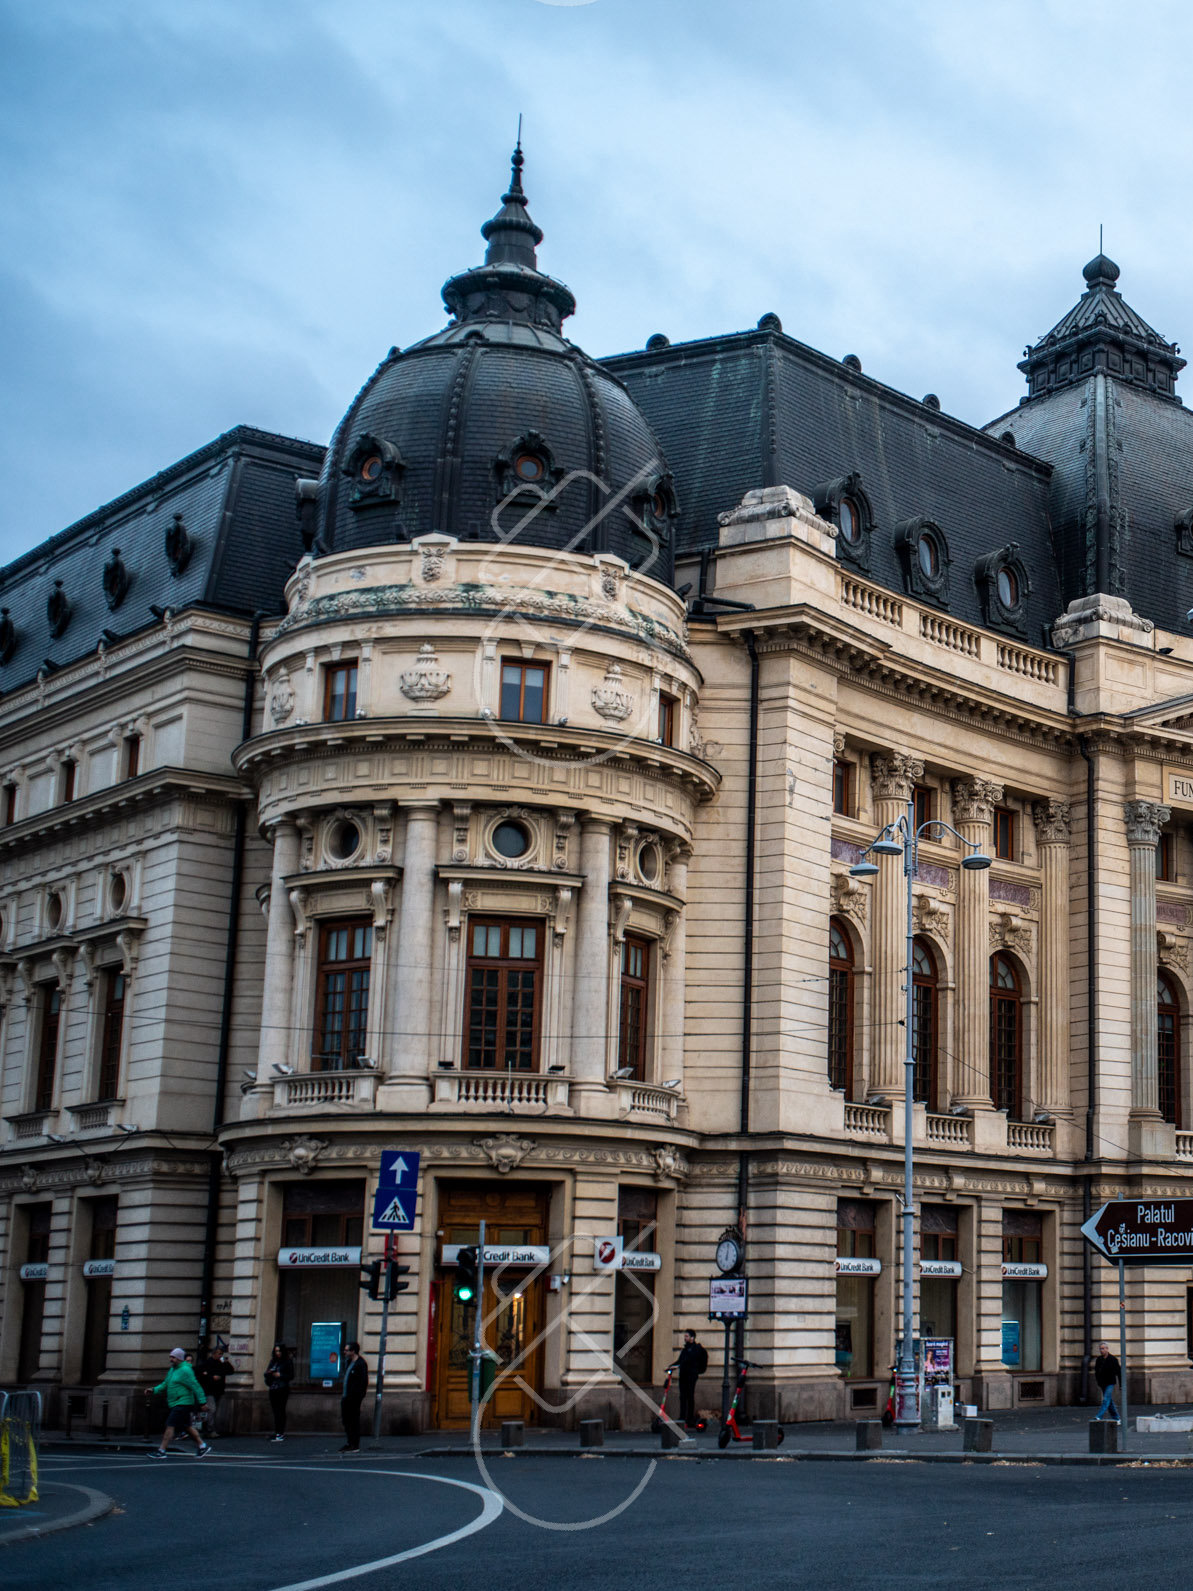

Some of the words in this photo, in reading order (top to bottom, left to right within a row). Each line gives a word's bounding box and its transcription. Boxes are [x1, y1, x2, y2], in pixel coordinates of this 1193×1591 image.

[1137, 1203, 1175, 1224] Palatul
[298, 1252, 330, 1264] UniCredit
[331, 1252, 350, 1262] Bank
[511, 1250, 535, 1262] Bank
[840, 1263, 861, 1272] UniCredit
[861, 1263, 874, 1272] Bank
[923, 1265, 943, 1274] UniCredit
[943, 1265, 955, 1274] Bank
[1008, 1266, 1028, 1275] UniCredit
[1028, 1267, 1040, 1276] Bank
